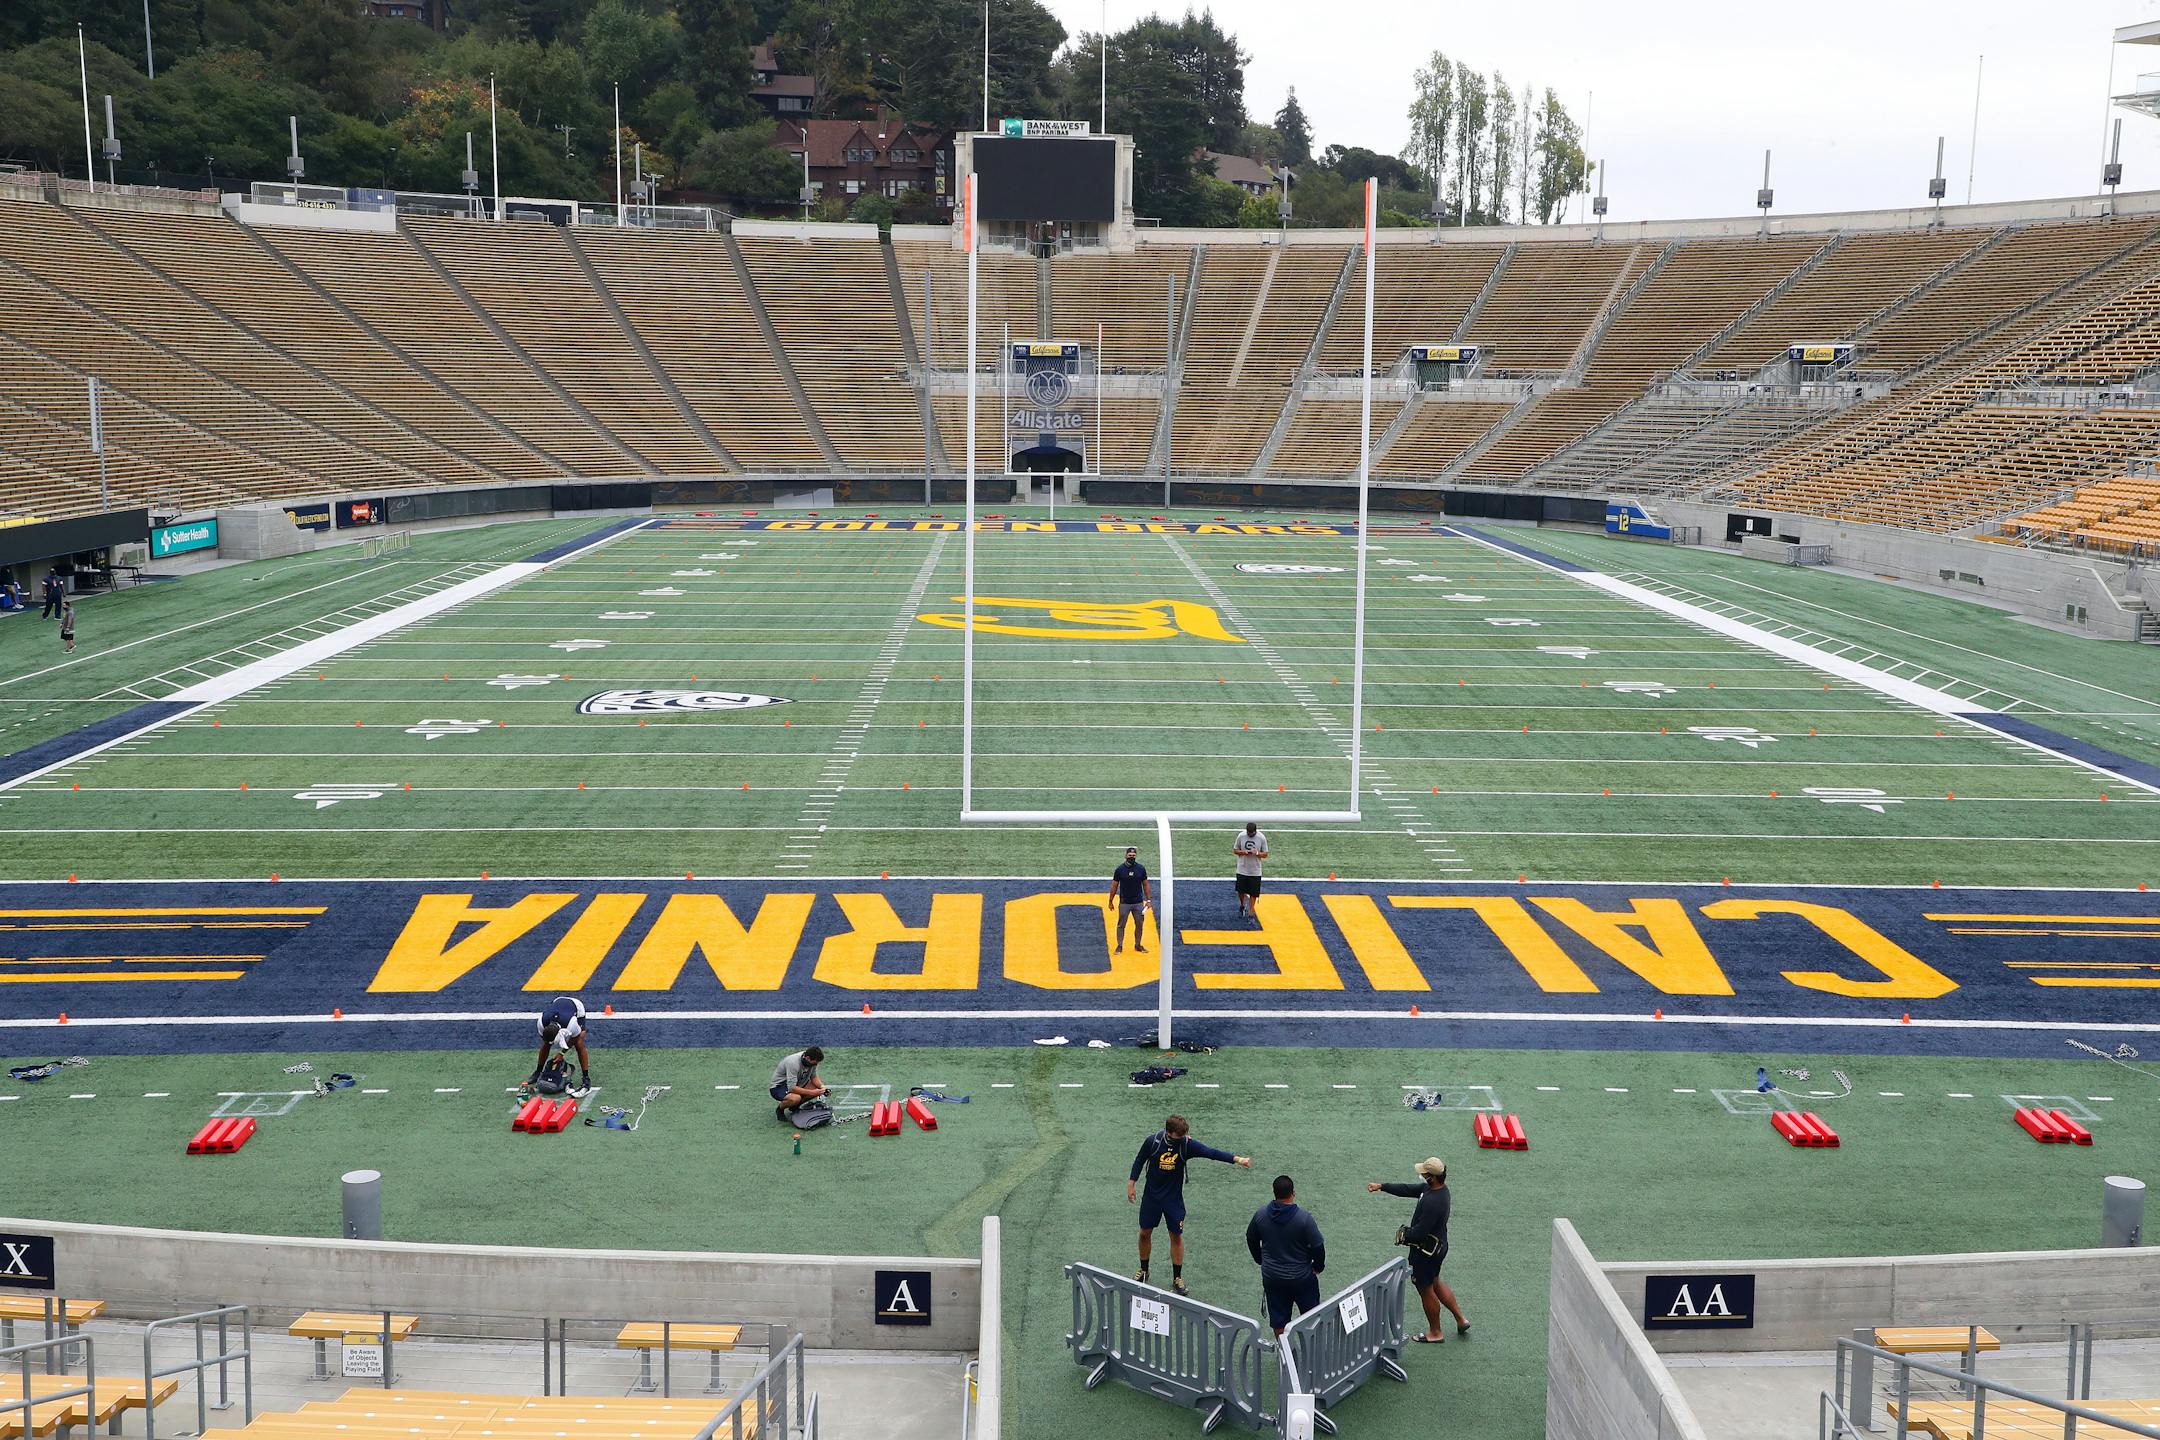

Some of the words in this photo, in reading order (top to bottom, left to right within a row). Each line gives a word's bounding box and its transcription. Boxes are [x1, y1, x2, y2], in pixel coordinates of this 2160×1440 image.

[1026, 121, 1052, 130] BANK
[1060, 122, 1085, 131] WEST
[1031, 345, 1060, 355] California
[1428, 348, 1457, 358] California
[1804, 348, 1833, 359] California
[1010, 409, 1082, 429] Allstate
[765, 521, 1056, 532] GOLDEN
[1096, 522, 1341, 535] BEARS
[1618, 514, 1629, 531] 12
[171, 531, 189, 545] Sutter
[189, 527, 209, 541] Health
[404, 719, 493, 734] 20
[1686, 726, 1780, 742] 20
[292, 783, 399, 800] 10
[1801, 787, 1905, 804] 10
[366, 892, 1961, 1000] CALIFORNIA
[1159, 1151, 1179, 1164] Cal
[0, 1243, 33, 1275] X
[887, 1279, 919, 1312] A
[1667, 1283, 1732, 1316] AA
[1160, 1305, 1165, 1314] 3
[1141, 1320, 1146, 1329] 5
[1154, 1323, 1159, 1332] 2
